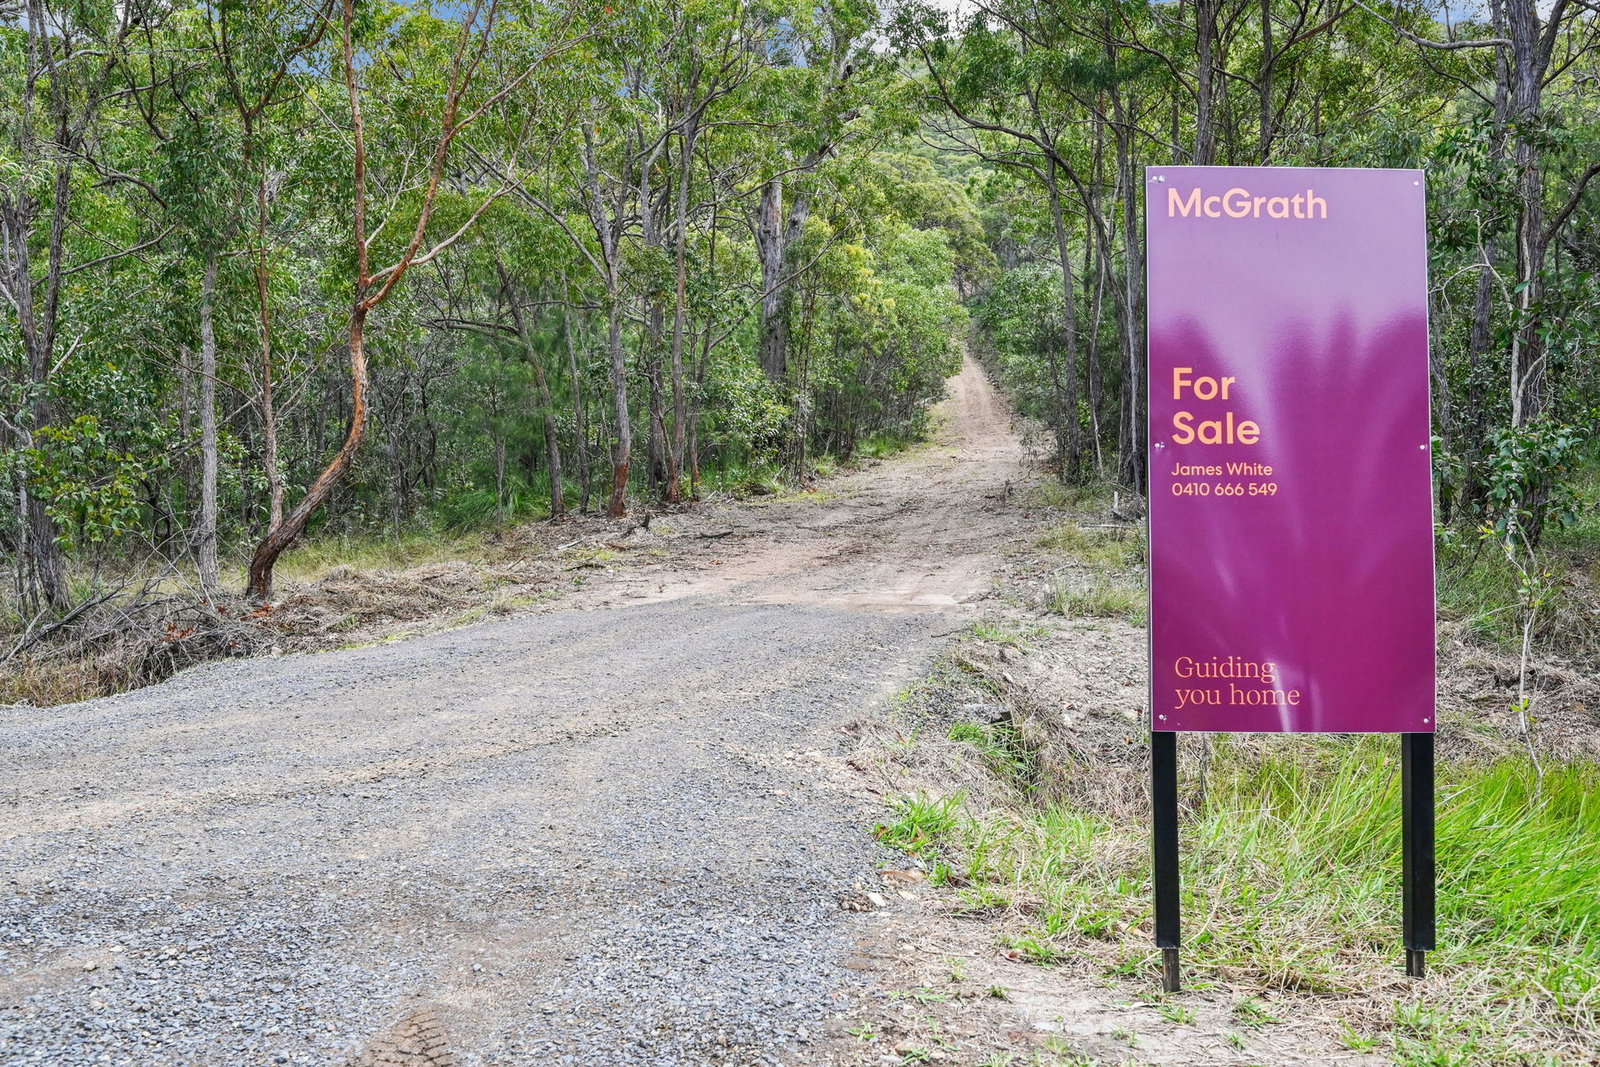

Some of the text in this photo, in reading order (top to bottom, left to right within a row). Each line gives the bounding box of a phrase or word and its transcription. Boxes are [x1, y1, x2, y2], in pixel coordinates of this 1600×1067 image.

[1168, 188, 1328, 219] McGrath
[1173, 367, 1236, 400] For
[1172, 411, 1260, 445] Sale
[1171, 462, 1273, 476] James White
[1172, 482, 1278, 496] 0410 666 549
[1175, 656, 1276, 683] Guiding
[1175, 683, 1300, 709] you home
